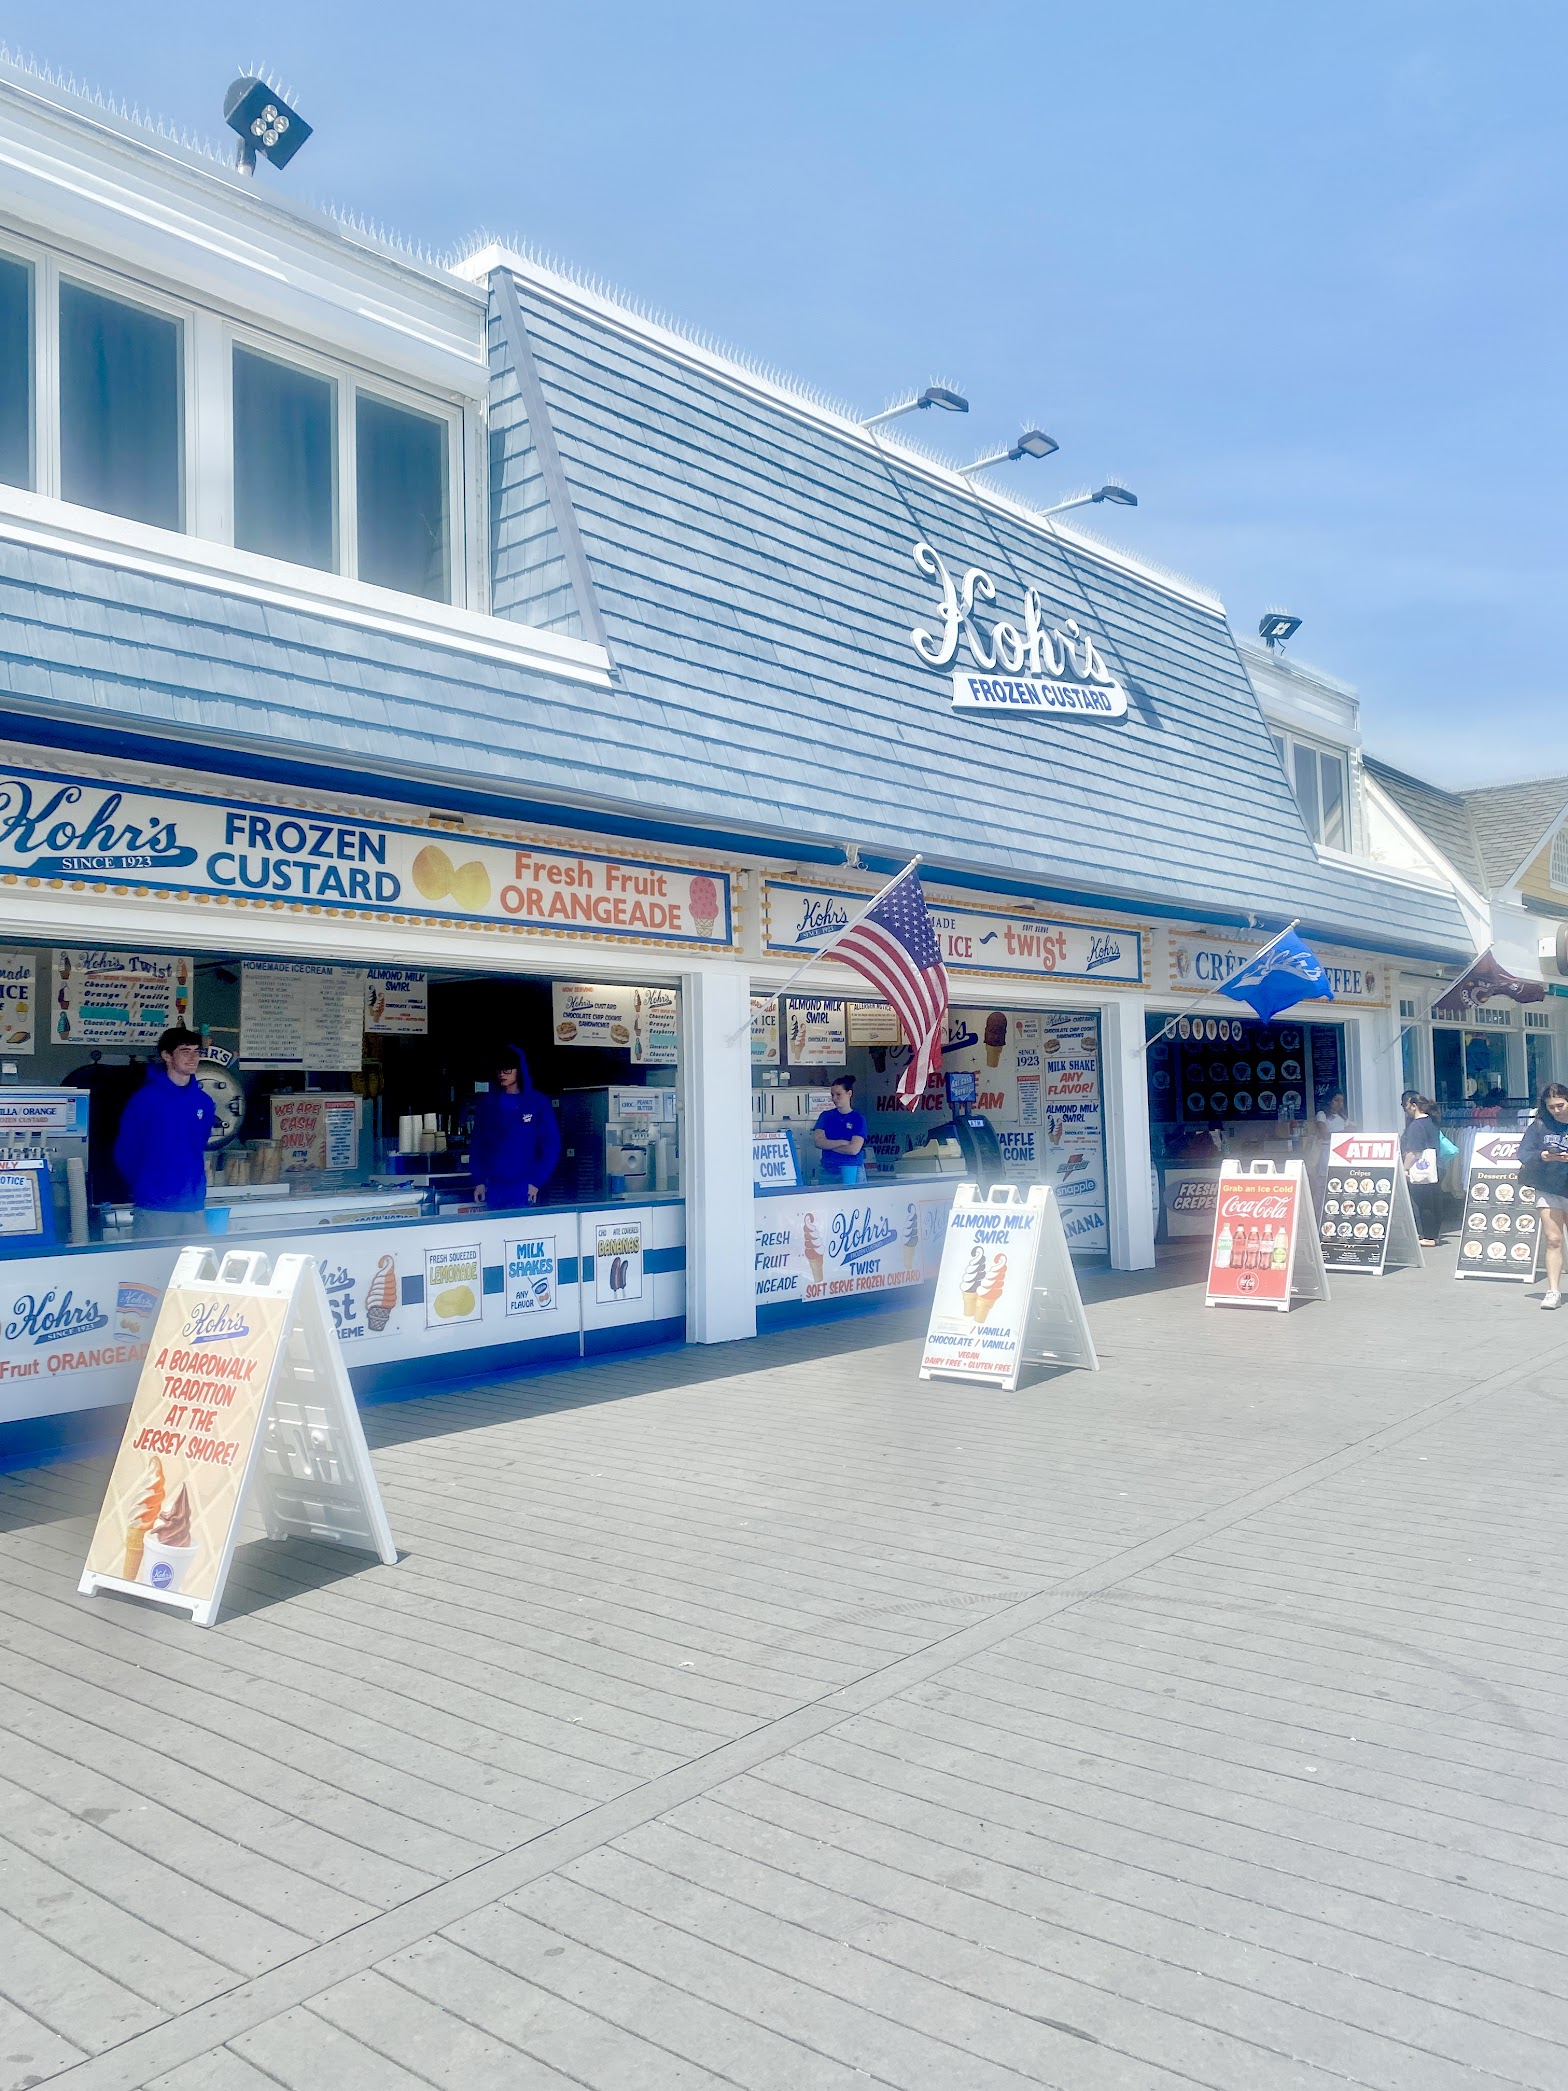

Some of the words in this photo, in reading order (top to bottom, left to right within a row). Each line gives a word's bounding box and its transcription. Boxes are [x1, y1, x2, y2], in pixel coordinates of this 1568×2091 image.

[910, 542, 1113, 685] Kohr's
[967, 678, 1043, 706] FROZEN
[1041, 684, 1112, 712] CUSTARD
[0, 781, 177, 853] Kohr's
[225, 812, 386, 865] FROZEN
[62, 856, 114, 870] SINCE
[121, 855, 152, 868] 1923
[206, 851, 401, 902] CUSTARD
[515, 851, 594, 889] Fresh
[606, 864, 667, 898] Fruit
[500, 885, 682, 931] ORANGEADE
[797, 898, 849, 931] Kohr's
[1022, 924, 1034, 932] SOFT
[1035, 925, 1049, 934] SERVE
[948, 935, 973, 958] ICE
[1087, 935, 1121, 962] Kohr's
[128, 956, 173, 978] Twist
[243, 961, 290, 972] HOMEMADE
[291, 964, 304, 973] ICE
[305, 965, 333, 975] CREAM
[367, 969, 402, 980] ALMOND
[405, 971, 425, 982] MILK
[84, 981, 127, 989] Chocolate
[385, 981, 410, 991] SWIRL
[84, 990, 120, 999] Orange
[84, 1000, 128, 1009] Raspberry
[789, 999, 822, 1010] ALMOND
[824, 1000, 841, 1011] MILK
[563, 1012, 592, 1020] CHOCOLATE
[761, 1015, 776, 1026] ICE
[806, 1012, 830, 1024] SWIRL
[1016, 1056, 1040, 1067] 1923
[1047, 1060, 1066, 1073] MILK
[1069, 1059, 1096, 1072] SHAKE
[1060, 1072, 1083, 1083] ANY
[1048, 1082, 1094, 1096] FLAVOR!
[274, 1102, 294, 1116] WE
[296, 1102, 321, 1115] ARE
[921, 1094, 944, 1110] ICE
[1046, 1104, 1078, 1113] ALMOND
[1080, 1104, 1099, 1113] MILK
[22, 1107, 56, 1116] ORANGE
[1062, 1114, 1086, 1122] SWIRL
[280, 1116, 316, 1132] CASH
[1003, 1148, 1035, 1161] CONE
[1346, 1141, 1392, 1158] ATM
[760, 1161, 786, 1178] CONE
[1477, 1172, 1507, 1180] Dessert
[1056, 1180, 1095, 1197] snapple
[1179, 1183, 1218, 1196] FRESH
[1223, 1184, 1244, 1193] Grab
[1258, 1185, 1271, 1193] Ice
[1273, 1185, 1293, 1193] Cold
[1221, 1195, 1294, 1219] Coca-Cola
[951, 1214, 1001, 1229] ALMOND
[1003, 1215, 1035, 1230] MILK
[829, 1206, 892, 1258] Kohr's
[973, 1229, 1009, 1244] SWIRL
[516, 1242, 545, 1259] MILK
[597, 1237, 639, 1257] BANANAS
[429, 1253, 447, 1264] FRESH
[448, 1251, 477, 1263] SQUEEZED
[755, 1252, 790, 1270] FRUIT
[430, 1261, 478, 1285] LEMONADE
[508, 1258, 553, 1278] SHAKES
[850, 1259, 881, 1276] TWIST
[806, 1282, 827, 1298] SOFT
[829, 1278, 854, 1295] SERVE
[856, 1276, 885, 1291] FROZEN
[887, 1269, 921, 1284] CUSTARD
[516, 1291, 528, 1300] ANY
[510, 1299, 534, 1310] FLAVOR
[5, 1291, 99, 1340] Kohr's
[182, 1302, 244, 1337] Kohr's
[47, 1328, 73, 1340] SINCE
[77, 1323, 94, 1333] 1923
[977, 1326, 1011, 1337] VANILLA
[928, 1335, 973, 1347] CHOCOLATE
[982, 1339, 1016, 1350] VANILLA
[958, 1351, 980, 1360] VEGAN
[0, 1359, 39, 1379] Fruit
[155, 1348, 169, 1369] A
[169, 1349, 257, 1381] BOARDWALK
[924, 1357, 944, 1365] DAIRY
[945, 1358, 962, 1367] FREE
[967, 1361, 994, 1370] GLUTEN
[994, 1363, 1012, 1372] FREE
[162, 1376, 237, 1407] TRADITION
[164, 1404, 188, 1427] AT
[188, 1408, 217, 1432] THE
[133, 1427, 187, 1456] JERSEY
[185, 1435, 240, 1467] SHORE!
